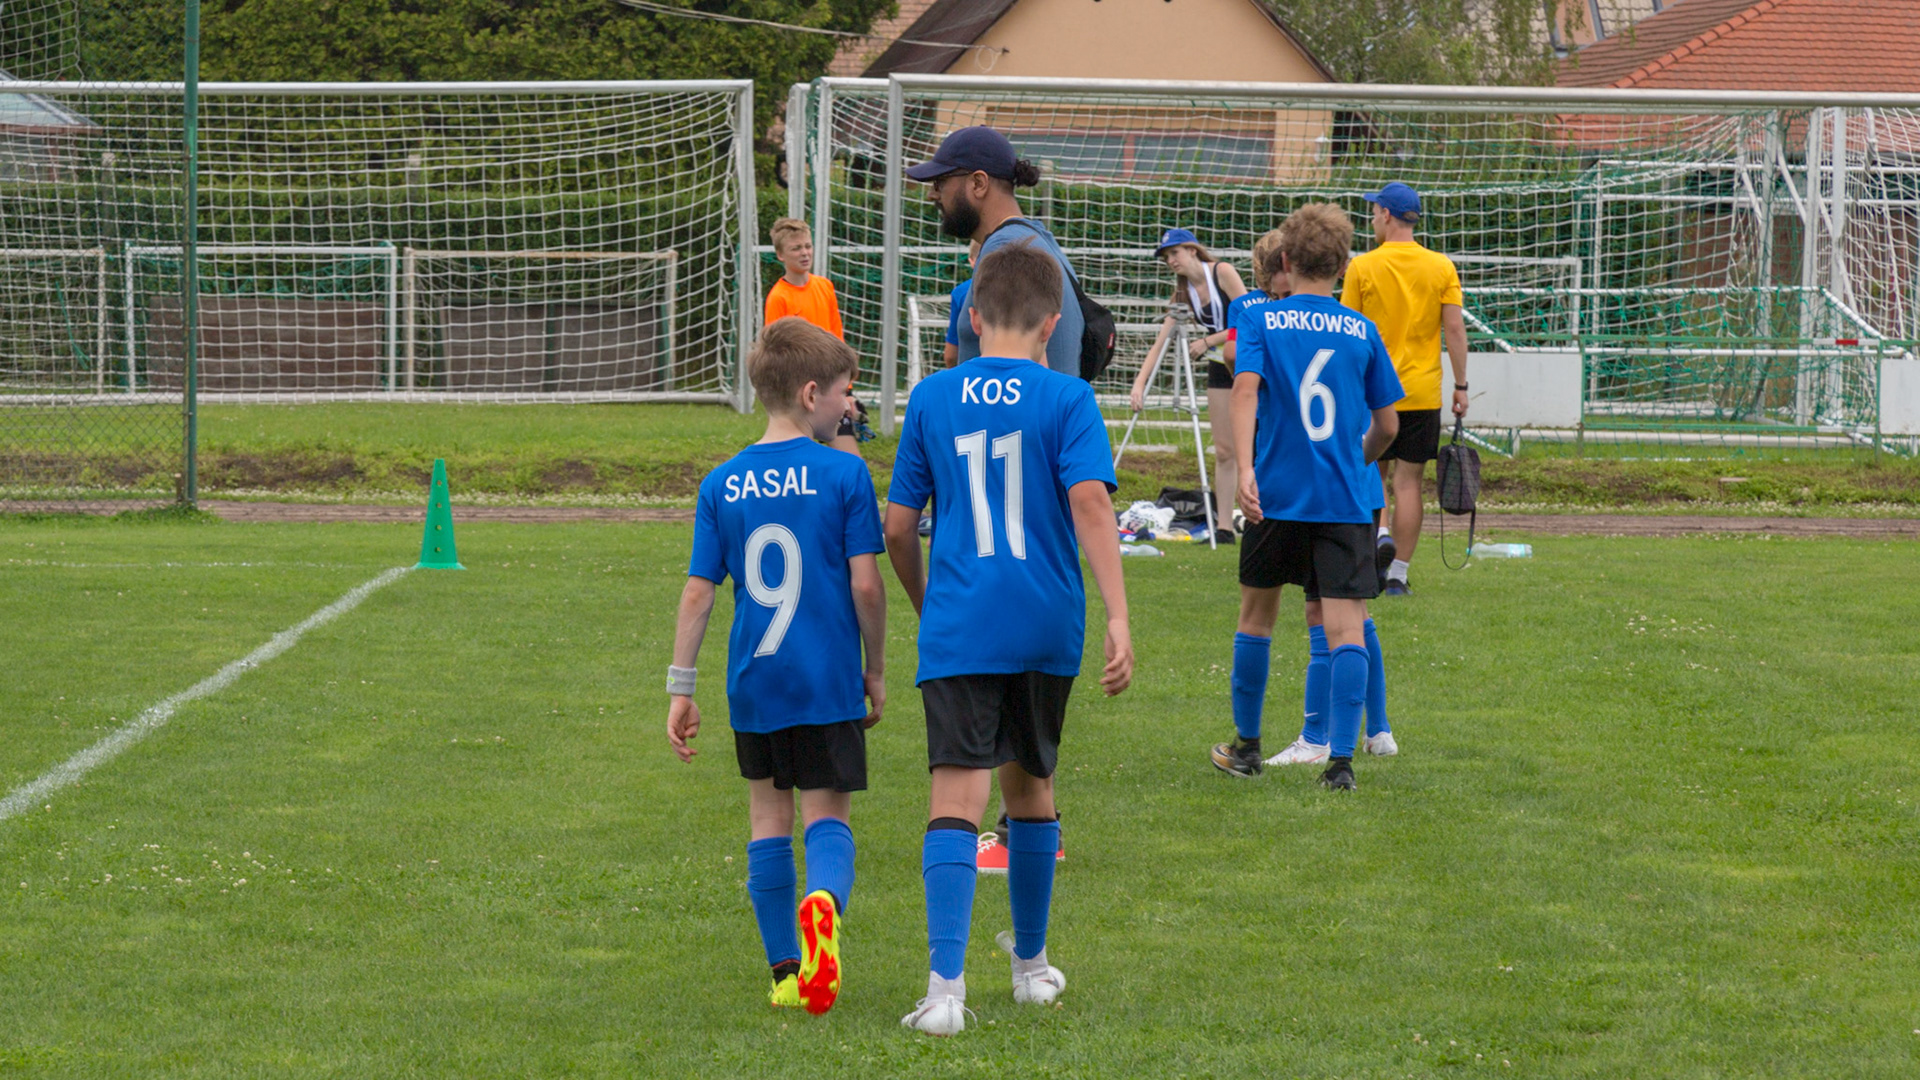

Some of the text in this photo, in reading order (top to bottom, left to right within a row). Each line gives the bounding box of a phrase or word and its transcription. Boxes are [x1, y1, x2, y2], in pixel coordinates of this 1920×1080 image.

[1264, 310, 1366, 340] BORKOWSKI
[962, 377, 1022, 405] KOS
[1299, 348, 1336, 442] 6
[724, 466, 817, 502] SASAL
[955, 430, 1026, 560] 11
[745, 523, 802, 658] 9
